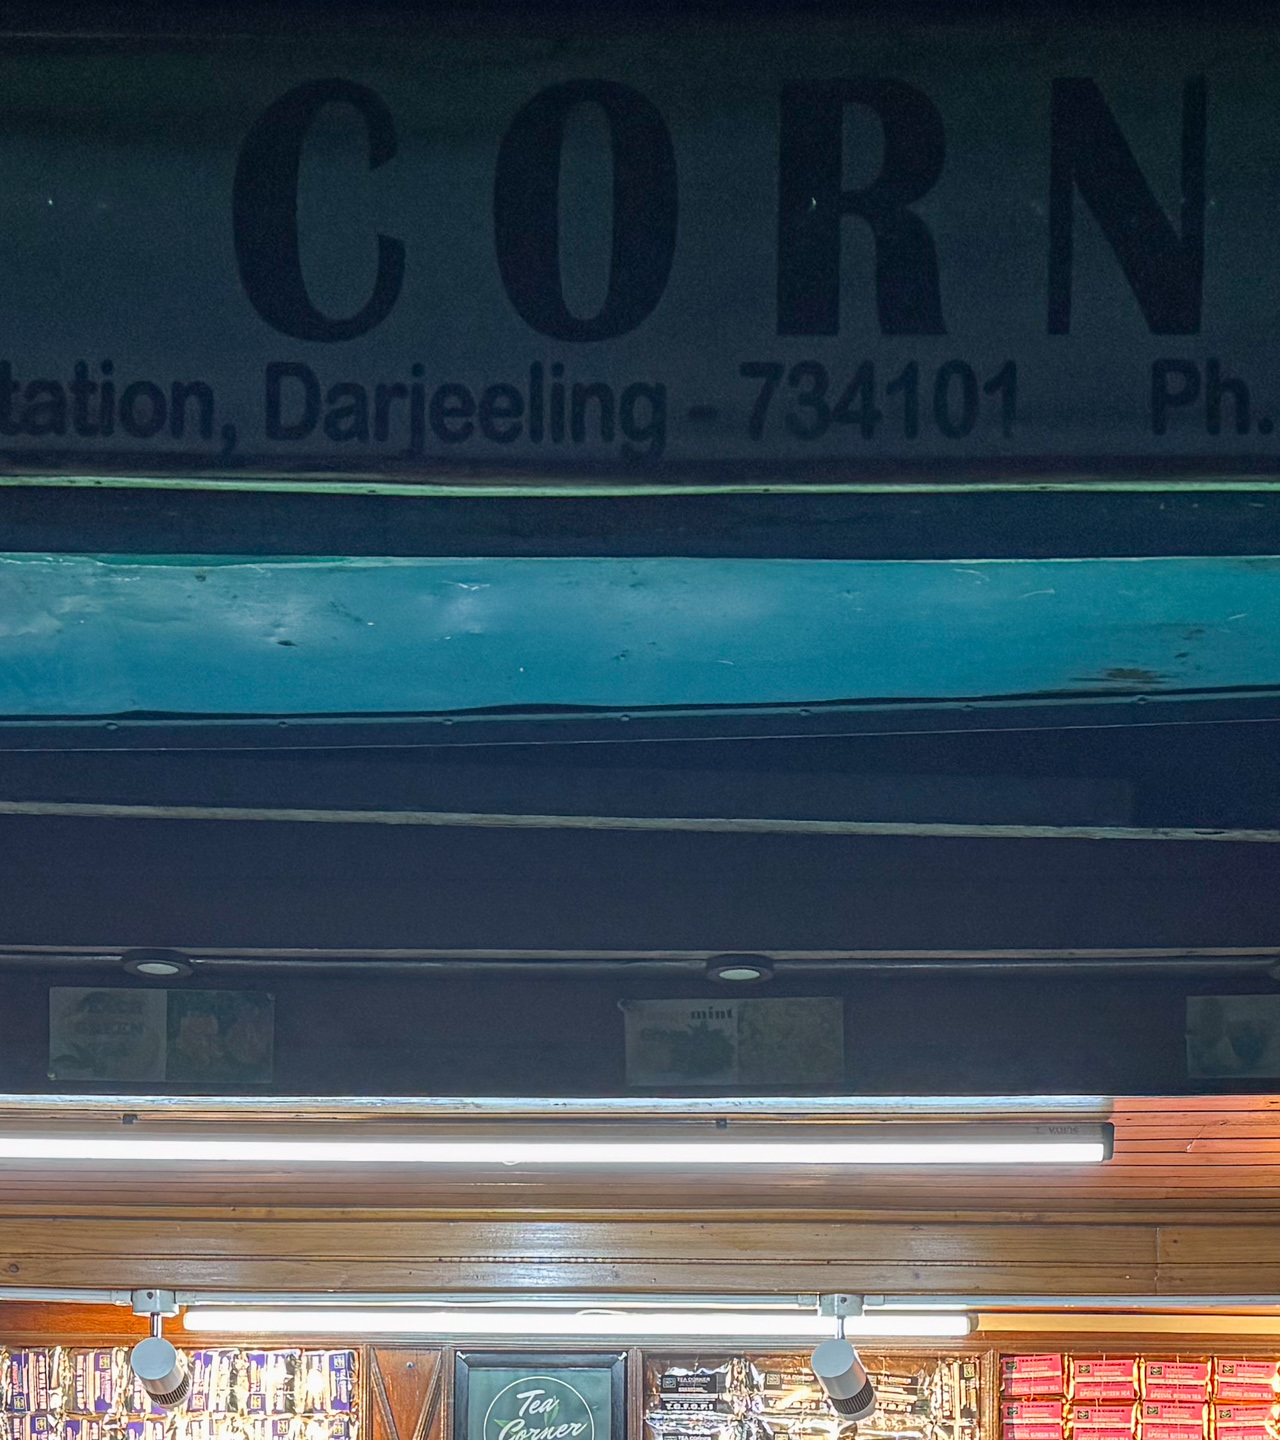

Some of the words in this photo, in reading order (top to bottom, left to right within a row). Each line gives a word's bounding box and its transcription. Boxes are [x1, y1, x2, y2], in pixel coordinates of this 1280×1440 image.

[265, 360, 667, 460] Darjeeling
[739, 358, 1018, 441] 734101
[1150, 356, 1273, 436] Ph.
[516, 1389, 560, 1417] Tea
